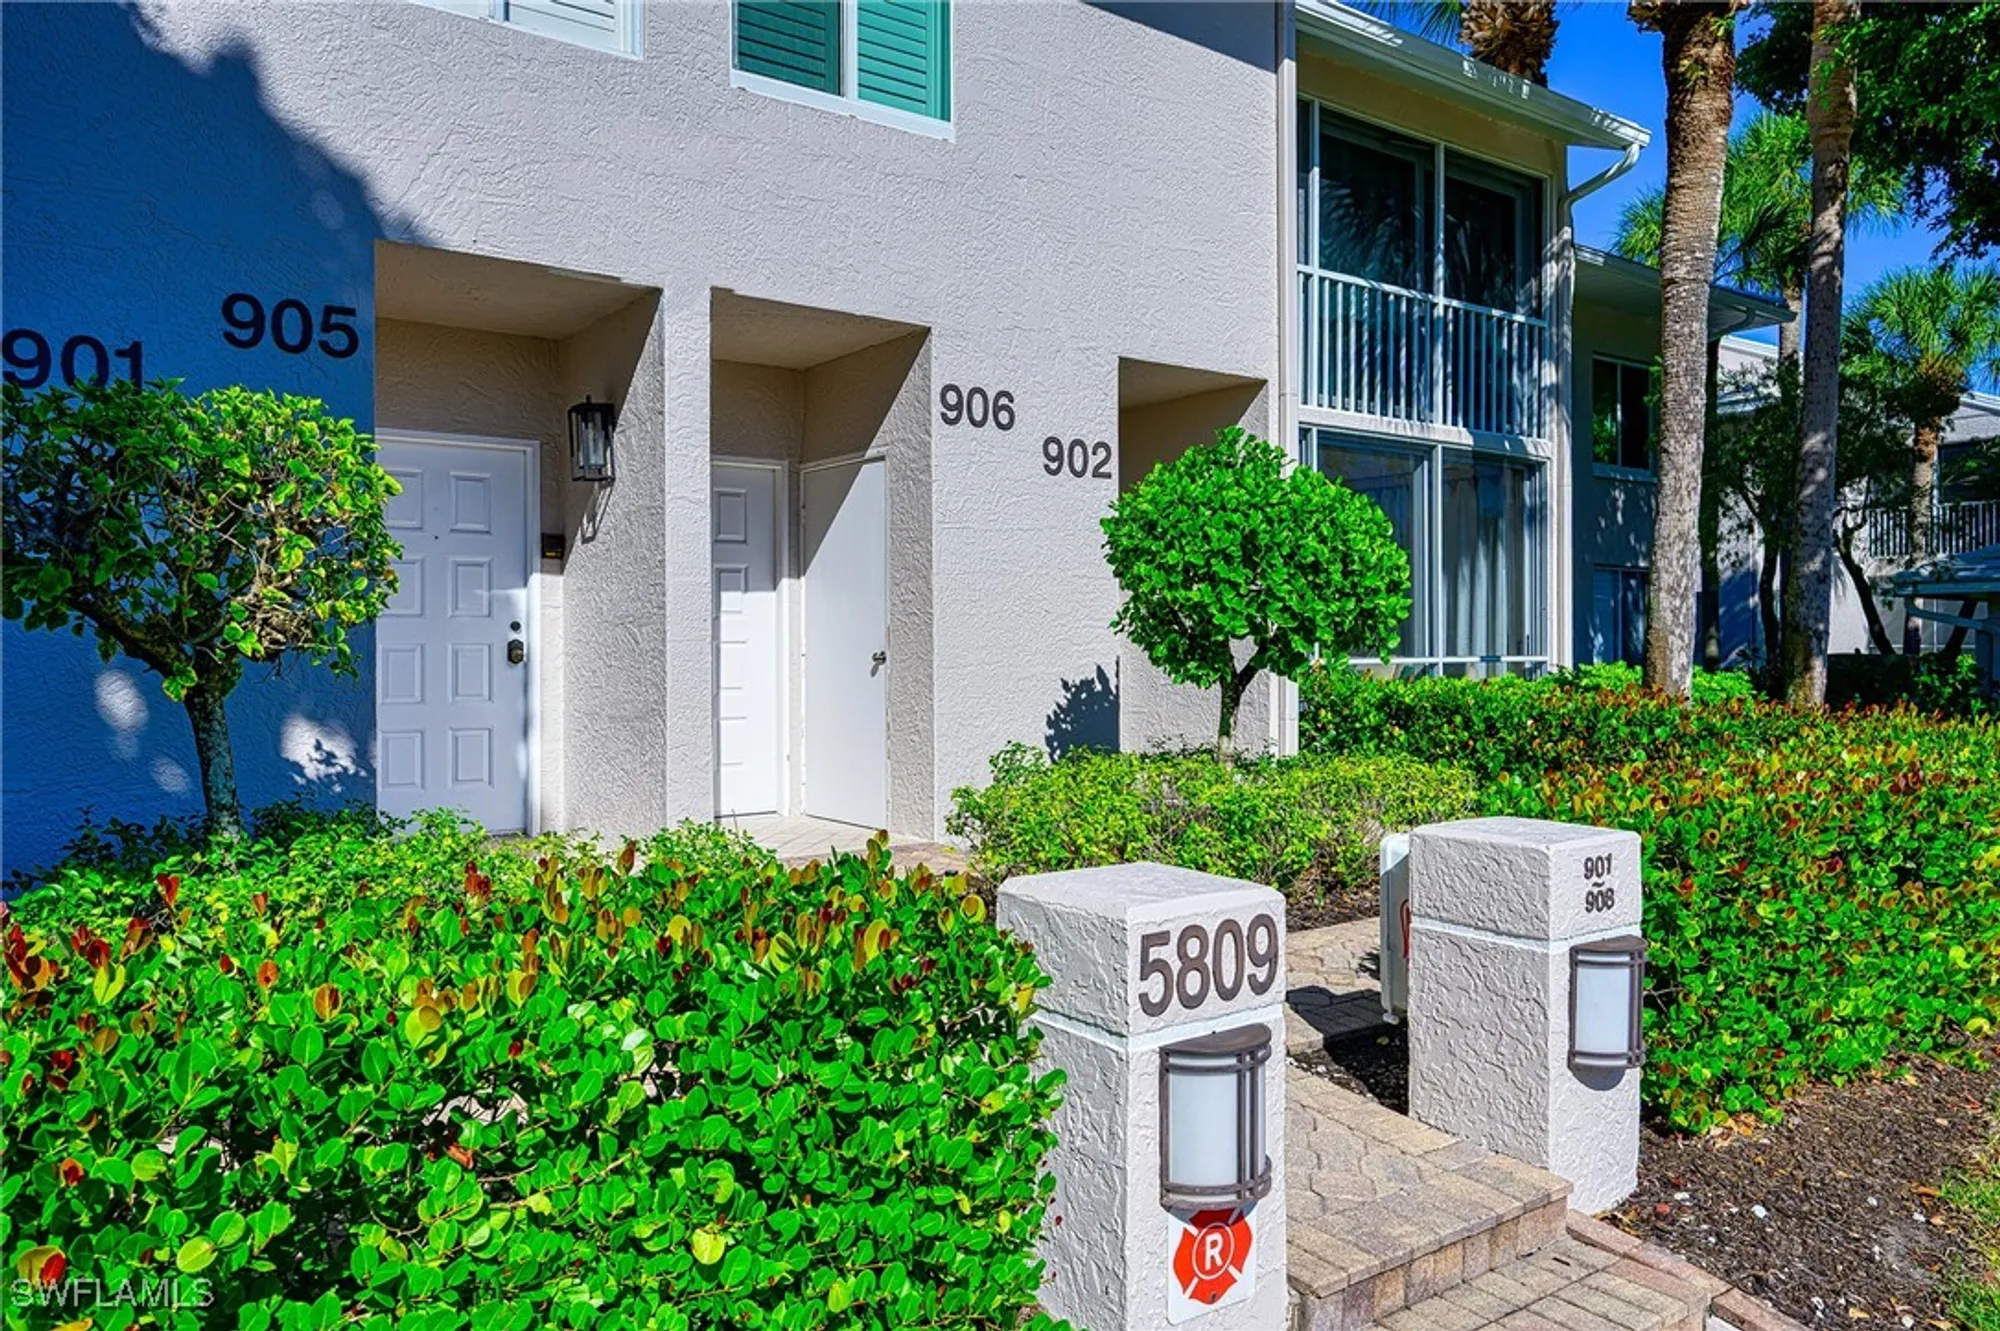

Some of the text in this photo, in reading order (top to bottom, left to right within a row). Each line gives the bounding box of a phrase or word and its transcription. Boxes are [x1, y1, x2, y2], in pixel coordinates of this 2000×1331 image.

[221, 292, 359, 359] 905
[0, 328, 144, 394] 901
[939, 383, 1015, 431] 906
[1042, 436, 1112, 479] 902
[1584, 852, 1613, 880] 901
[1585, 887, 1615, 913] 908
[1138, 913, 1279, 1018] 5809
[1205, 1231, 1224, 1271] R
